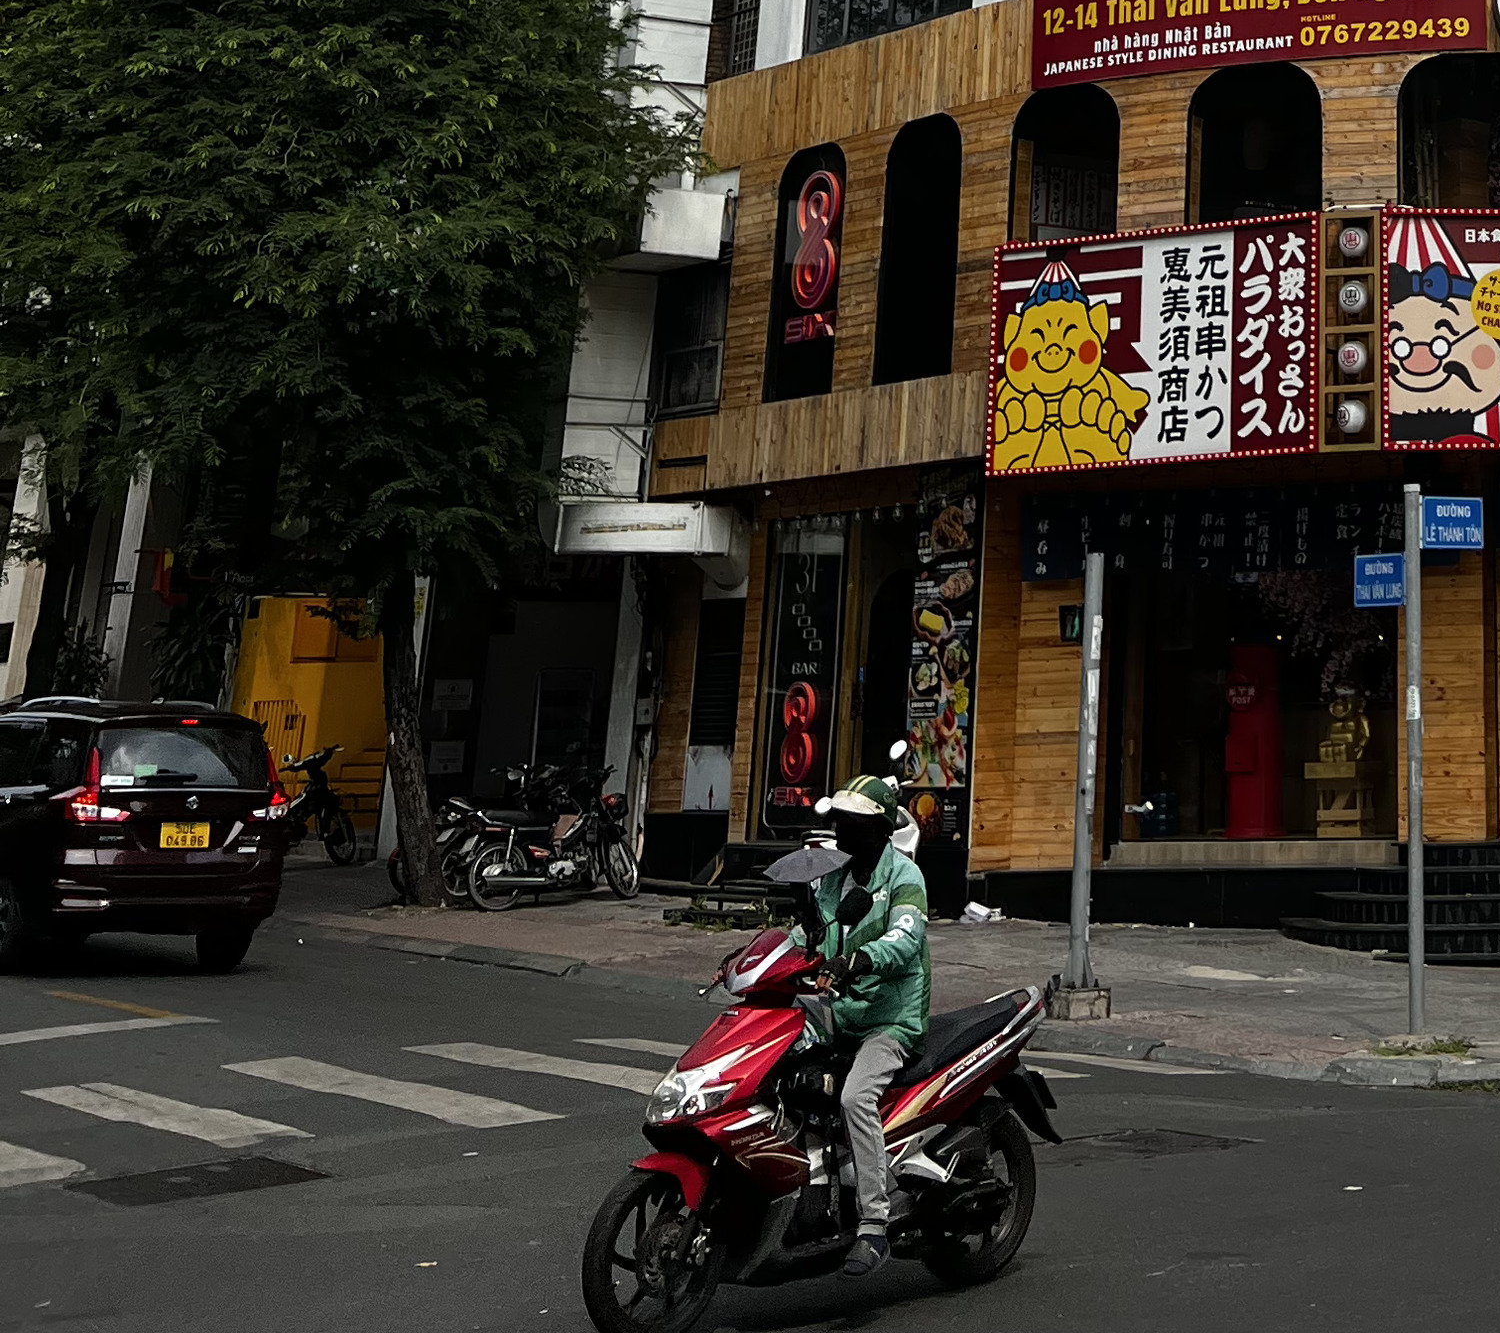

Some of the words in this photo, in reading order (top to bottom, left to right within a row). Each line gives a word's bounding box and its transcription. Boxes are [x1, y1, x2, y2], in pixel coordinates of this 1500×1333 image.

[1043, 2, 1098, 37] 12-14
[1300, 16, 1471, 47] 0767229439
[1093, 34, 1118, 54] nhà
[1124, 28, 1158, 50] hàng
[1165, 26, 1199, 46] Nhật
[1205, 21, 1232, 41] Bản
[1043, 56, 1104, 77] JAPANESE
[1107, 51, 1144, 66] STYLE
[1148, 43, 1197, 63] DINING
[1202, 35, 1294, 56] RESTAURANT
[1476, 300, 1492, 313] NO
[1195, 244, 1229, 439] 元祖串かつ
[1236, 233, 1275, 438] パラダイス
[1277, 231, 1306, 434] 大衆おっさん
[1436, 504, 1471, 518] ĐƯỜNG
[1081, 515, 1092, 571] 生ビー
[1425, 523, 1436, 542] LÊ
[1438, 523, 1464, 542] THÁNH
[1465, 523, 1482, 543] TÔN
[1365, 560, 1394, 575] ĐƯỜNG
[1356, 581, 1371, 600] THÁI
[1372, 580, 1385, 600] VĂN
[1386, 583, 1402, 600] LUNG
[791, 662, 818, 675] BAR
